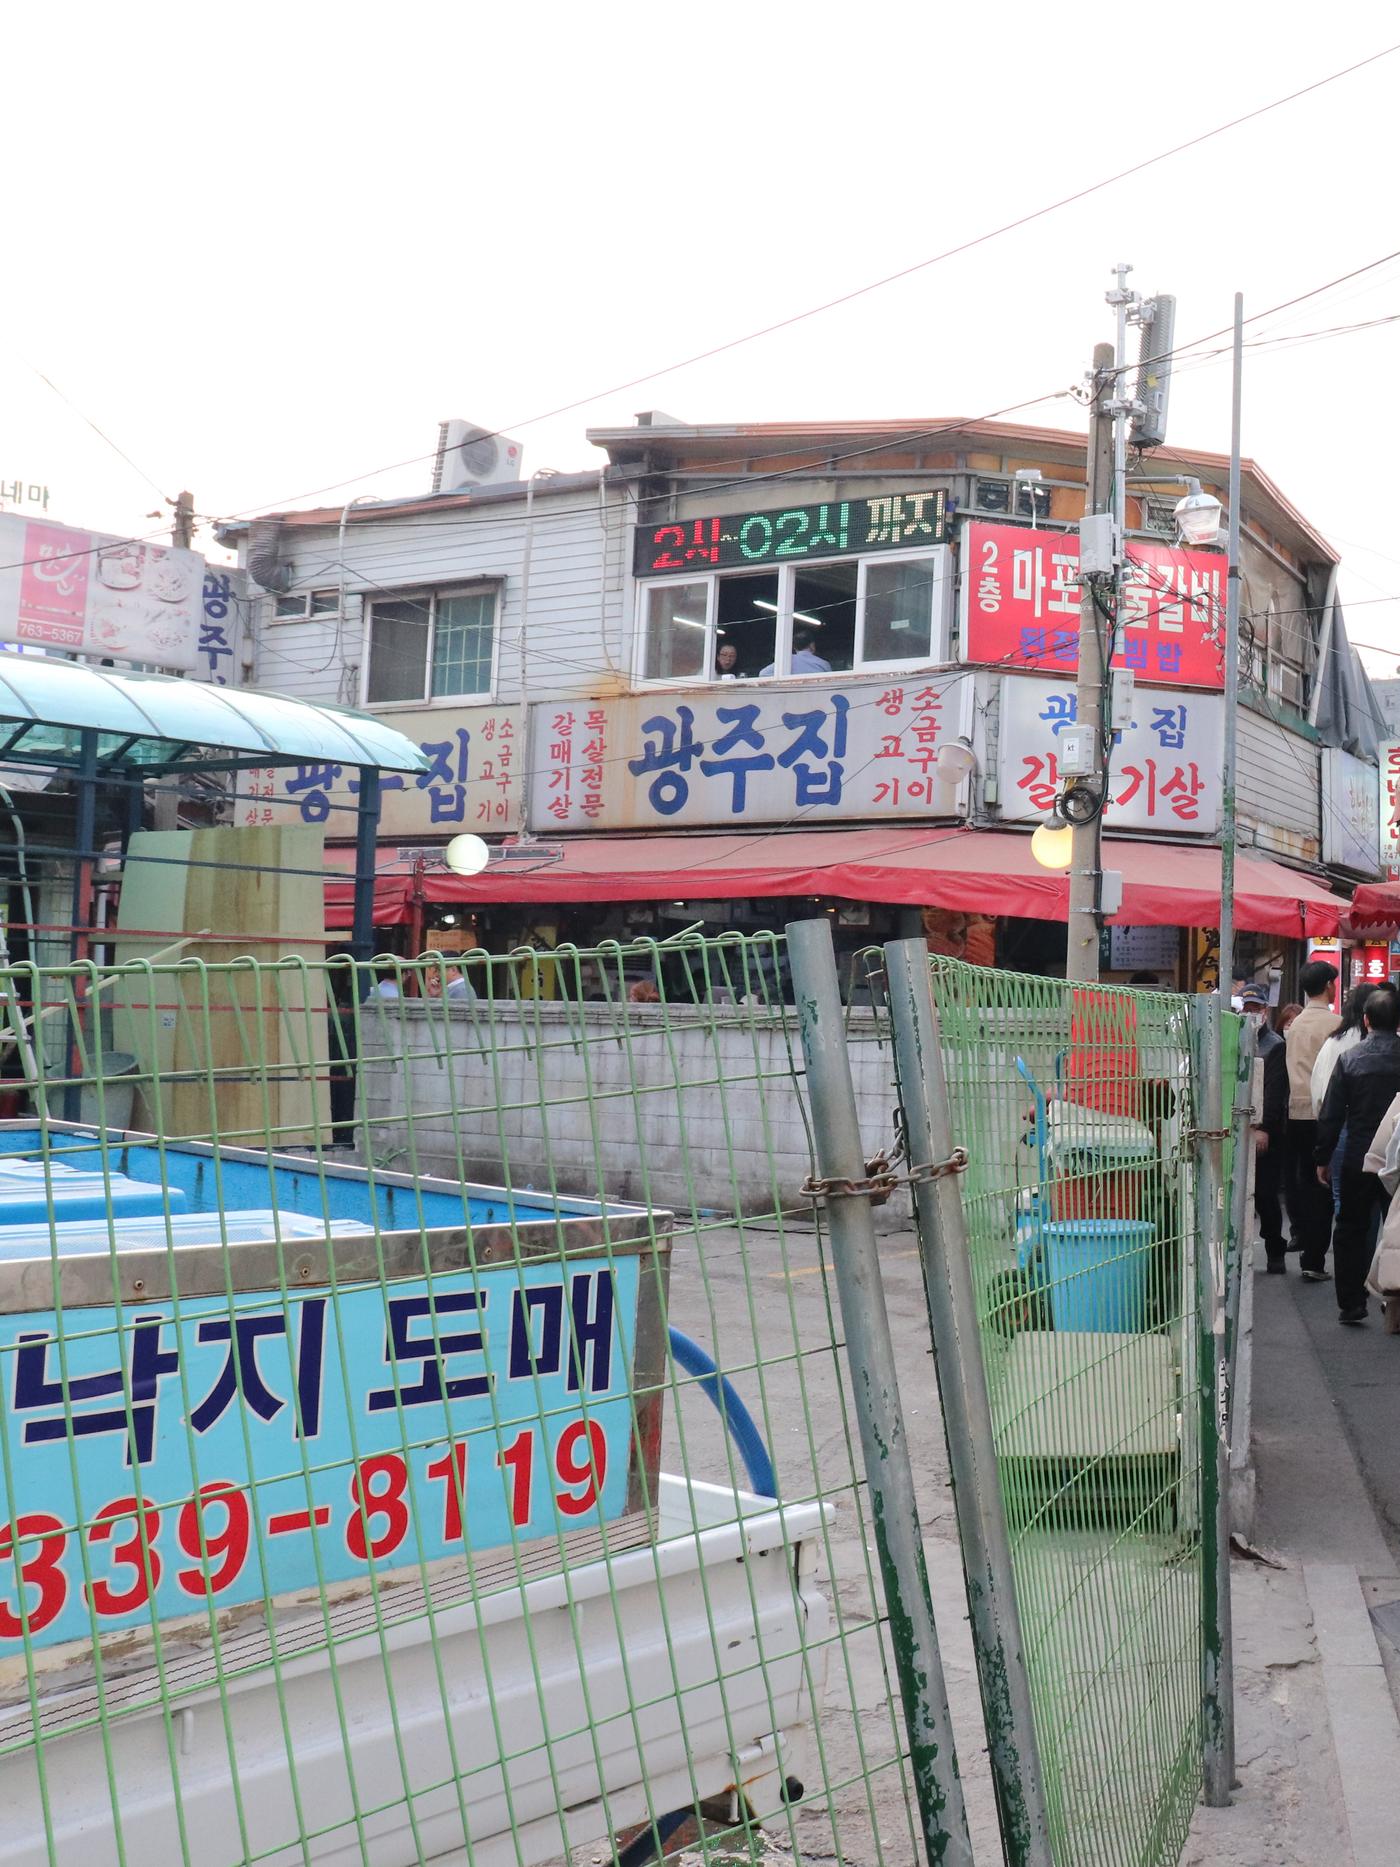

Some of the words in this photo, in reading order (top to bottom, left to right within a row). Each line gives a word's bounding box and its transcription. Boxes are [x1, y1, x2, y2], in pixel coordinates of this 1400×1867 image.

[865, 490, 943, 543] 까지
[20, 623, 83, 644] 763-5367
[198, 573, 233, 685] 광주
[1013, 547, 1220, 633] 마포불갈비
[1020, 627, 1183, 673] 된장빔밥
[547, 711, 577, 820] 갈매기살
[579, 708, 609, 818] 목살전문
[628, 694, 851, 816] 광주집
[907, 686, 944, 806] 소금구이
[1038, 693, 1188, 750] 광집
[285, 727, 471, 824] 광집
[1017, 752, 1206, 821] 갈기살
[14, 1298, 327, 1466] 낙지
[368, 1270, 614, 1411] 도매
[0, 1419, 608, 1638] 339-8119
